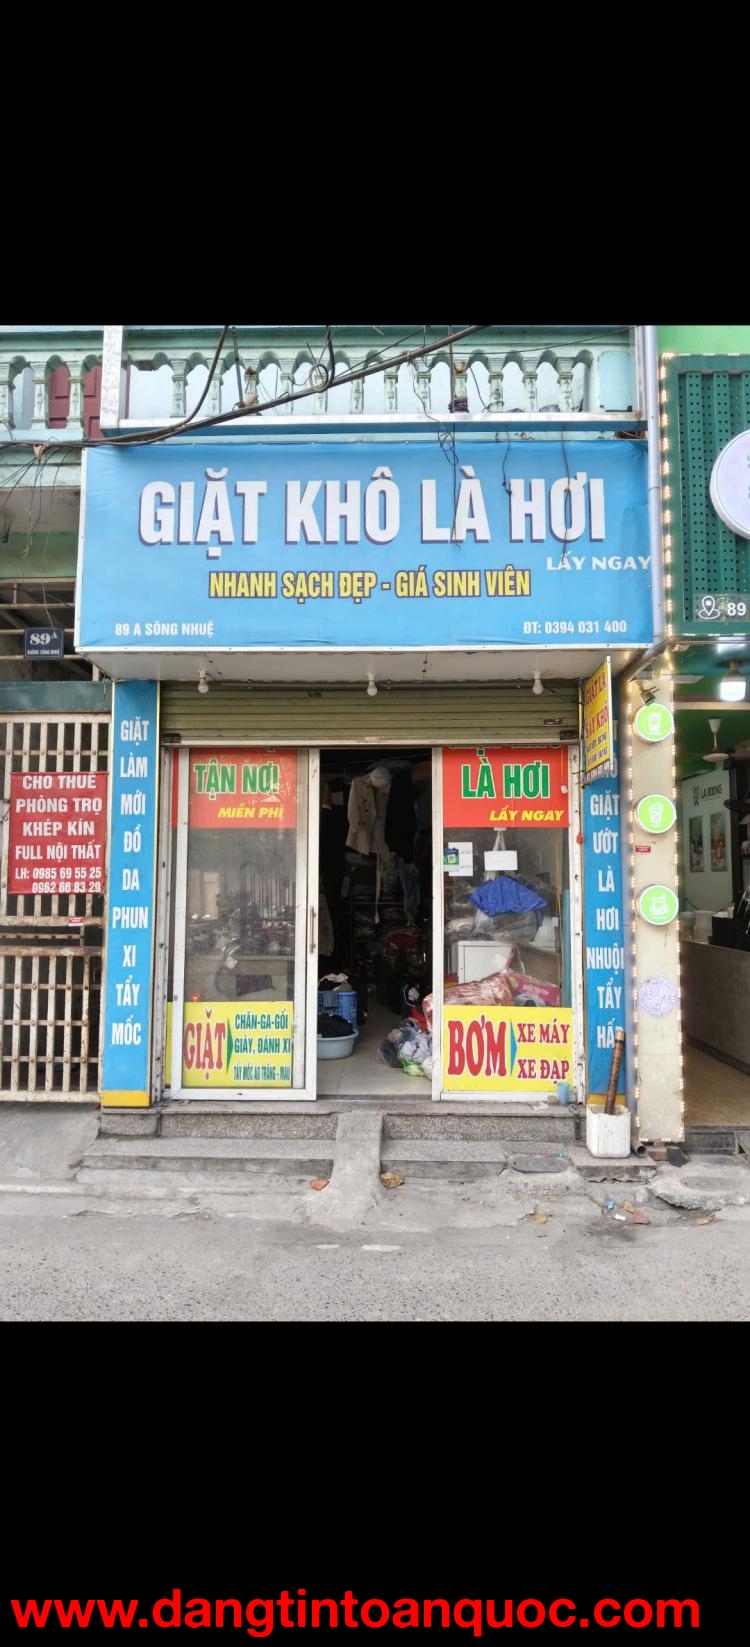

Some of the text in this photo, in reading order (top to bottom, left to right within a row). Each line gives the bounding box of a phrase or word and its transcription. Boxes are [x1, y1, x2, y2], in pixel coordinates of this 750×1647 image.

[138, 466, 606, 560] GIẶT KHÔ LÀ HƠI
[546, 551, 652, 570] LẤY NGAY
[209, 571, 277, 598] NHANH
[281, 570, 335, 604] SẠCH
[338, 570, 377, 604] ĐẸP
[394, 565, 429, 598] GIÁ
[432, 570, 481, 598] SINH
[485, 564, 531, 597] VIÊN
[727, 602, 746, 616] 89
[115, 620, 214, 639] 89 A SÔNG NHUỆ
[523, 620, 628, 634] ĐT: 0394 031 400
[120, 715, 150, 746] GIẶT
[120, 752, 148, 778] LÀM
[22, 775, 53, 790] CHO
[193, 757, 280, 800] TẬN NƠI
[461, 757, 496, 799] LÀ
[503, 760, 550, 799] HƠI
[15, 795, 102, 815] PHÒNG TRỌ
[120, 789, 146, 815] MỚI
[258, 804, 284, 818] PHÍ
[490, 805, 565, 821] LẤY NGAY
[590, 789, 619, 821] GIẶT
[22, 818, 95, 836] KHÉP KÍN
[15, 840, 101, 863] FULL NỘI THẤT
[592, 827, 618, 854] ƯỚT
[15, 867, 102, 879] LH: 0985 69 55 25
[122, 868, 140, 891] DA
[598, 865, 615, 892] LÀ
[112, 906, 149, 929] PHUN
[595, 906, 619, 930] HƠI
[122, 944, 136, 967] XI
[115, 974, 141, 1006] TẨY
[597, 977, 622, 1009] TẨY
[111, 1014, 142, 1045] MỐC
[235, 1009, 288, 1029] CHĂN-GA-GỐI
[517, 1018, 570, 1043] XE MÁY
[182, 1008, 226, 1080] GIẶT
[282, 1037, 291, 1053] XI
[447, 1014, 507, 1076] BƠM
[597, 1017, 624, 1048] HẤ
[517, 1059, 570, 1084] XE ĐẠP
